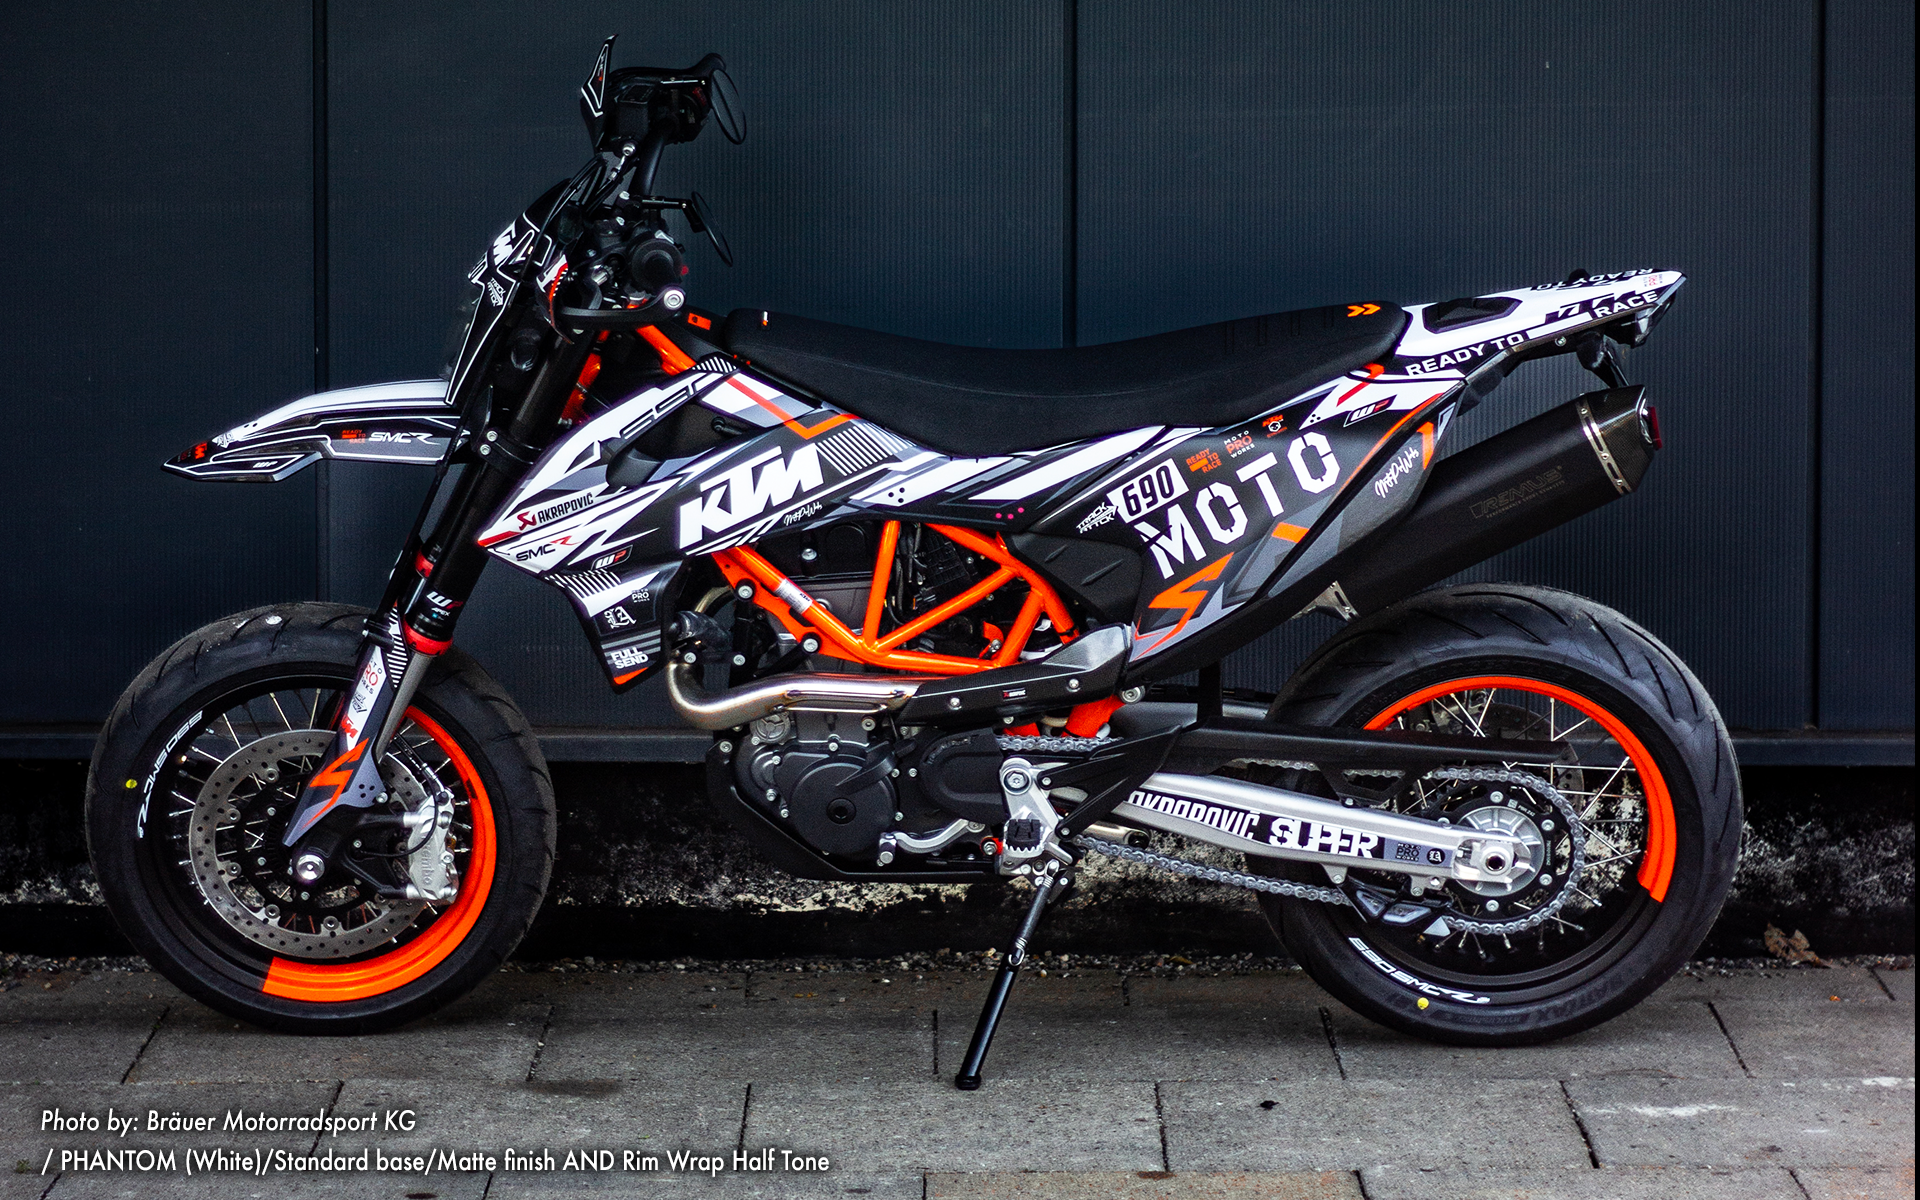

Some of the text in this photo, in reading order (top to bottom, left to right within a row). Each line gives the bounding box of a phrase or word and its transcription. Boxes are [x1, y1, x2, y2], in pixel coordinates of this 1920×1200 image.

[1404, 290, 1659, 377] READY TO RACE
[1351, 399, 1390, 421] WP
[1223, 430, 1250, 446] MOTO
[1225, 435, 1253, 454] PRO
[1185, 447, 1211, 466] READY
[1208, 452, 1220, 462] TO
[1230, 443, 1256, 459] WORKS
[1201, 458, 1223, 474] RACE
[679, 443, 824, 550] KTM
[1121, 465, 1175, 517] 690
[1482, 468, 1563, 514] REMUS
[1134, 431, 1341, 580] MOTO
[1075, 501, 1109, 530] TRACK
[595, 550, 627, 569] WP
[631, 591, 650, 601] PRO
[610, 646, 643, 661] FULL
[614, 653, 649, 669] SEND
[1268, 817, 1379, 859] SUPER
[1348, 937, 1397, 974] 690
